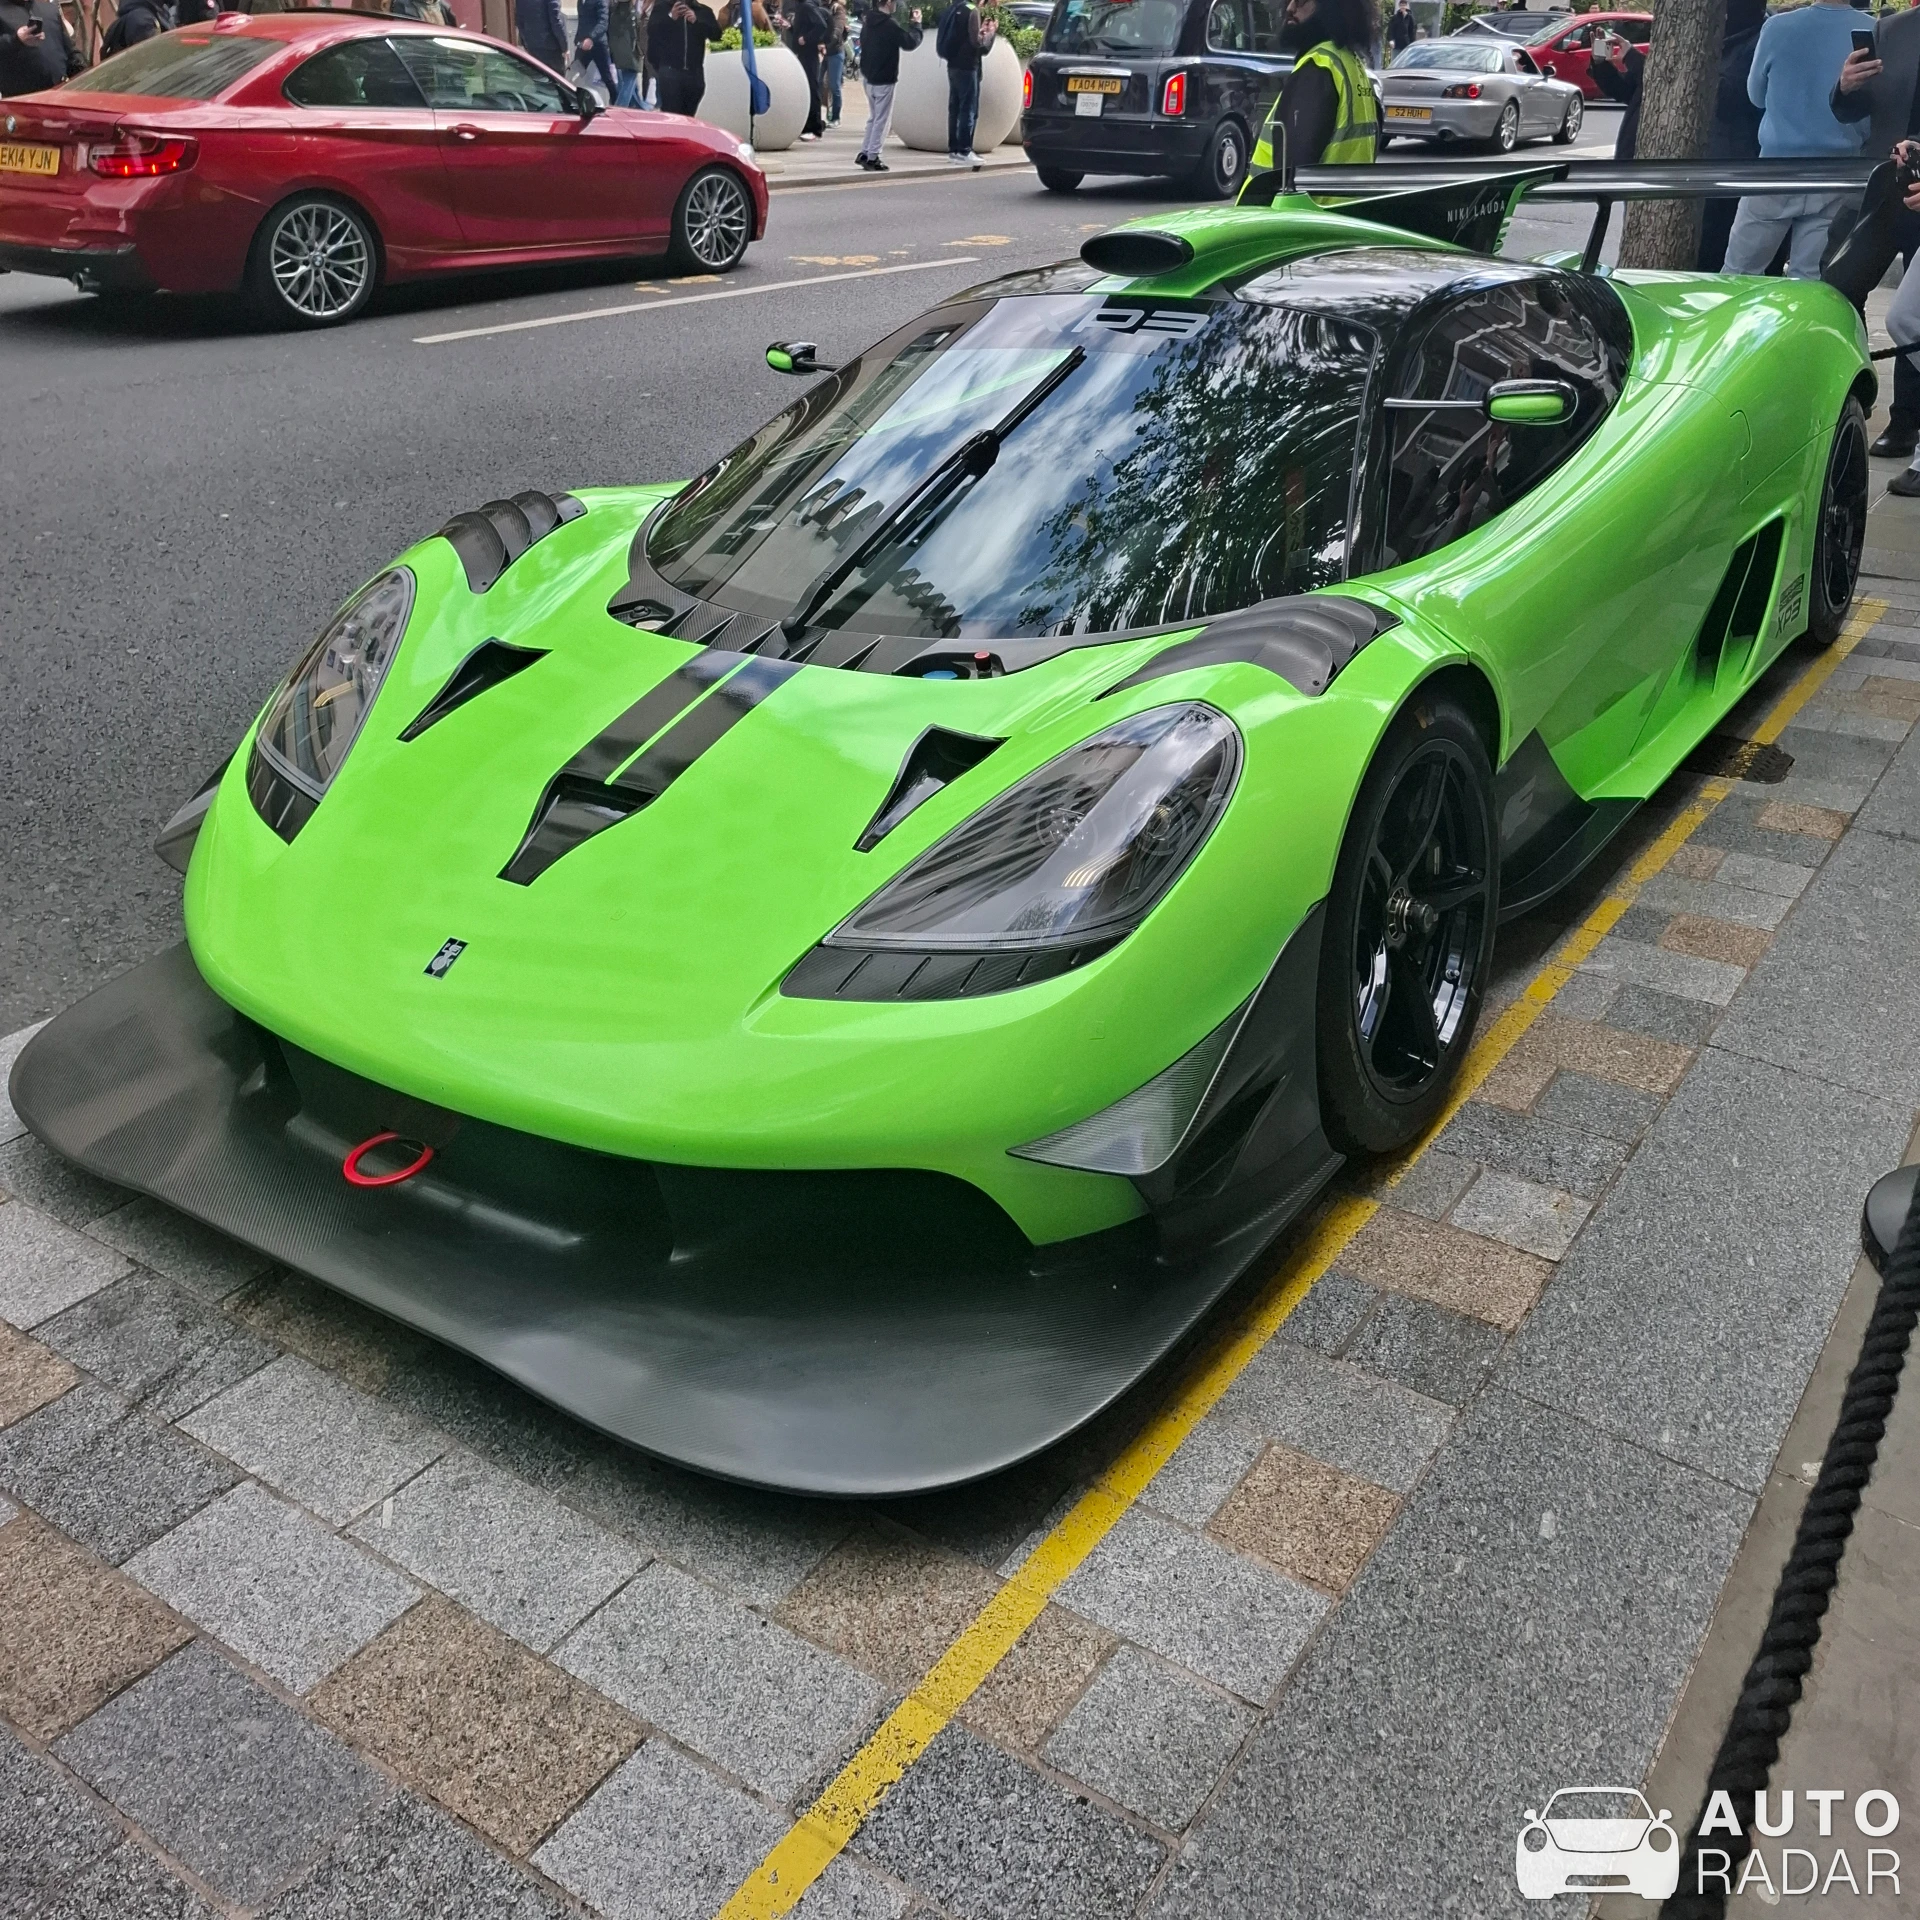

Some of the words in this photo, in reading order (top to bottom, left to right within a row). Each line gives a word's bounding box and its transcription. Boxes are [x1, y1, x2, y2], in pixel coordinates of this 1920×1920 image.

[1073, 79, 1096, 90] TA04
[1395, 108, 1405, 117] S2
[0, 147, 25, 168] EK14
[29, 149, 52, 170] YJN
[1447, 206, 1469, 222] NIKI
[1474, 200, 1505, 217] LAUDA
